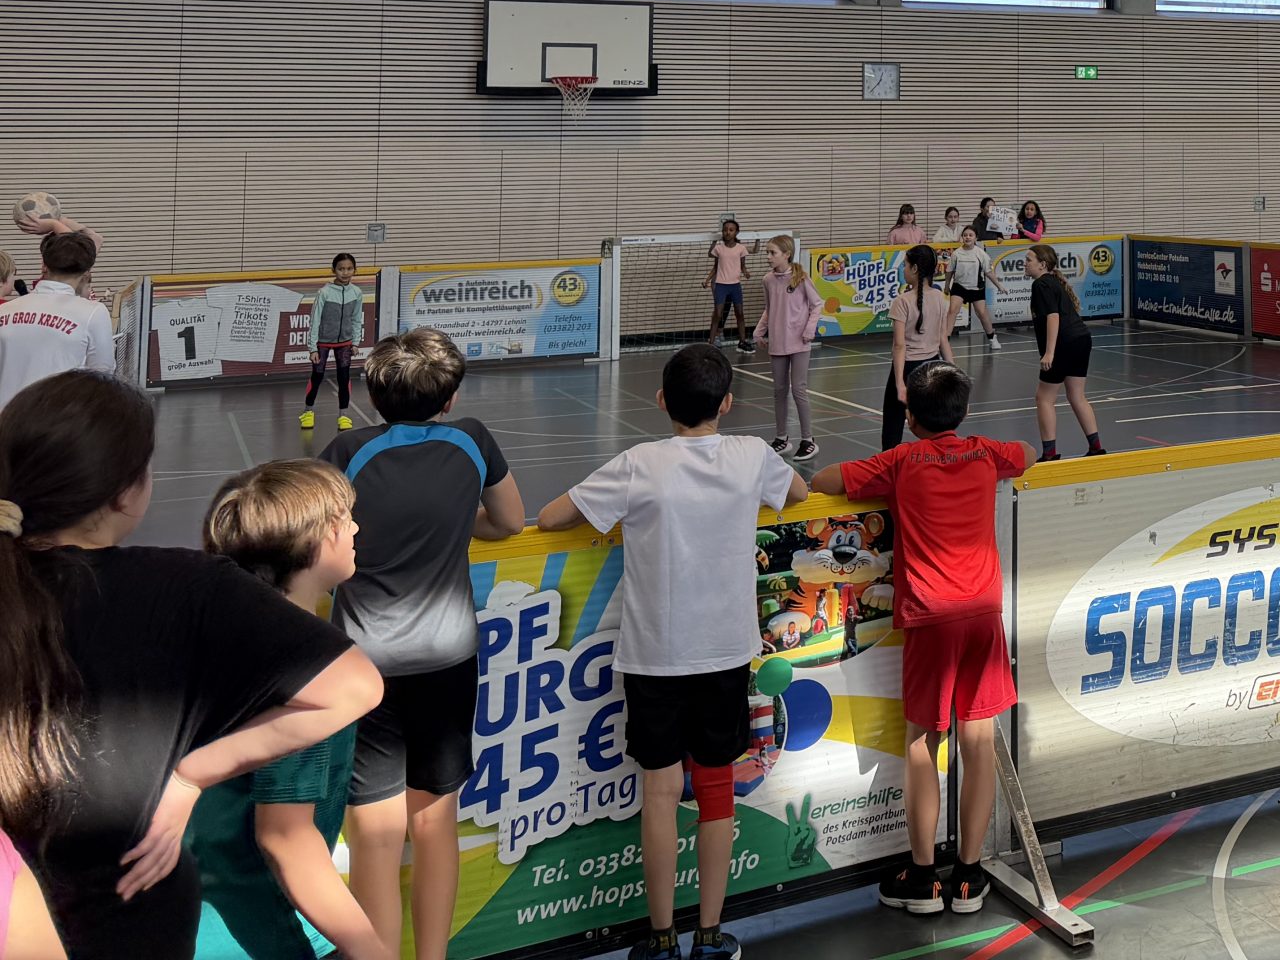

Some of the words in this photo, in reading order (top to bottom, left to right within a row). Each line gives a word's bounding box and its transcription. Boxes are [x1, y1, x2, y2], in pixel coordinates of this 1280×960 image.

[1001, 252, 1077, 272] weich
[1093, 250, 1108, 262] 43
[1137, 251, 1168, 261] ServiceCenter
[1169, 253, 1189, 262] Potsdam
[846, 261, 883, 281] HÜPF
[858, 271, 896, 291] BURG
[422, 280, 533, 303] weinreich
[557, 278, 578, 291] 43
[854, 294, 864, 302] ab
[865, 287, 885, 304] 45
[888, 284, 898, 299] €
[237, 295, 271, 304] T-Shirts
[874, 303, 887, 312] pro
[38, 312, 78, 335] KREUTZ
[169, 313, 206, 326] QUALITÄT
[234, 311, 269, 321] Trikots
[289, 315, 310, 329] WIR
[434, 320, 469, 329] Strandbad
[177, 326, 196, 360] 1
[289, 331, 311, 345] DEI
[168, 362, 186, 371] große
[474, 641, 615, 737] URG
[1226, 689, 1248, 711] by
[459, 723, 560, 814] 45
[578, 699, 625, 772] €
[510, 801, 566, 852] pro
[576, 773, 636, 814] Tag
[822, 824, 839, 835] des
[842, 808, 906, 830] Kreissportbun
[825, 822, 907, 847] Potsdam-Mittelm
